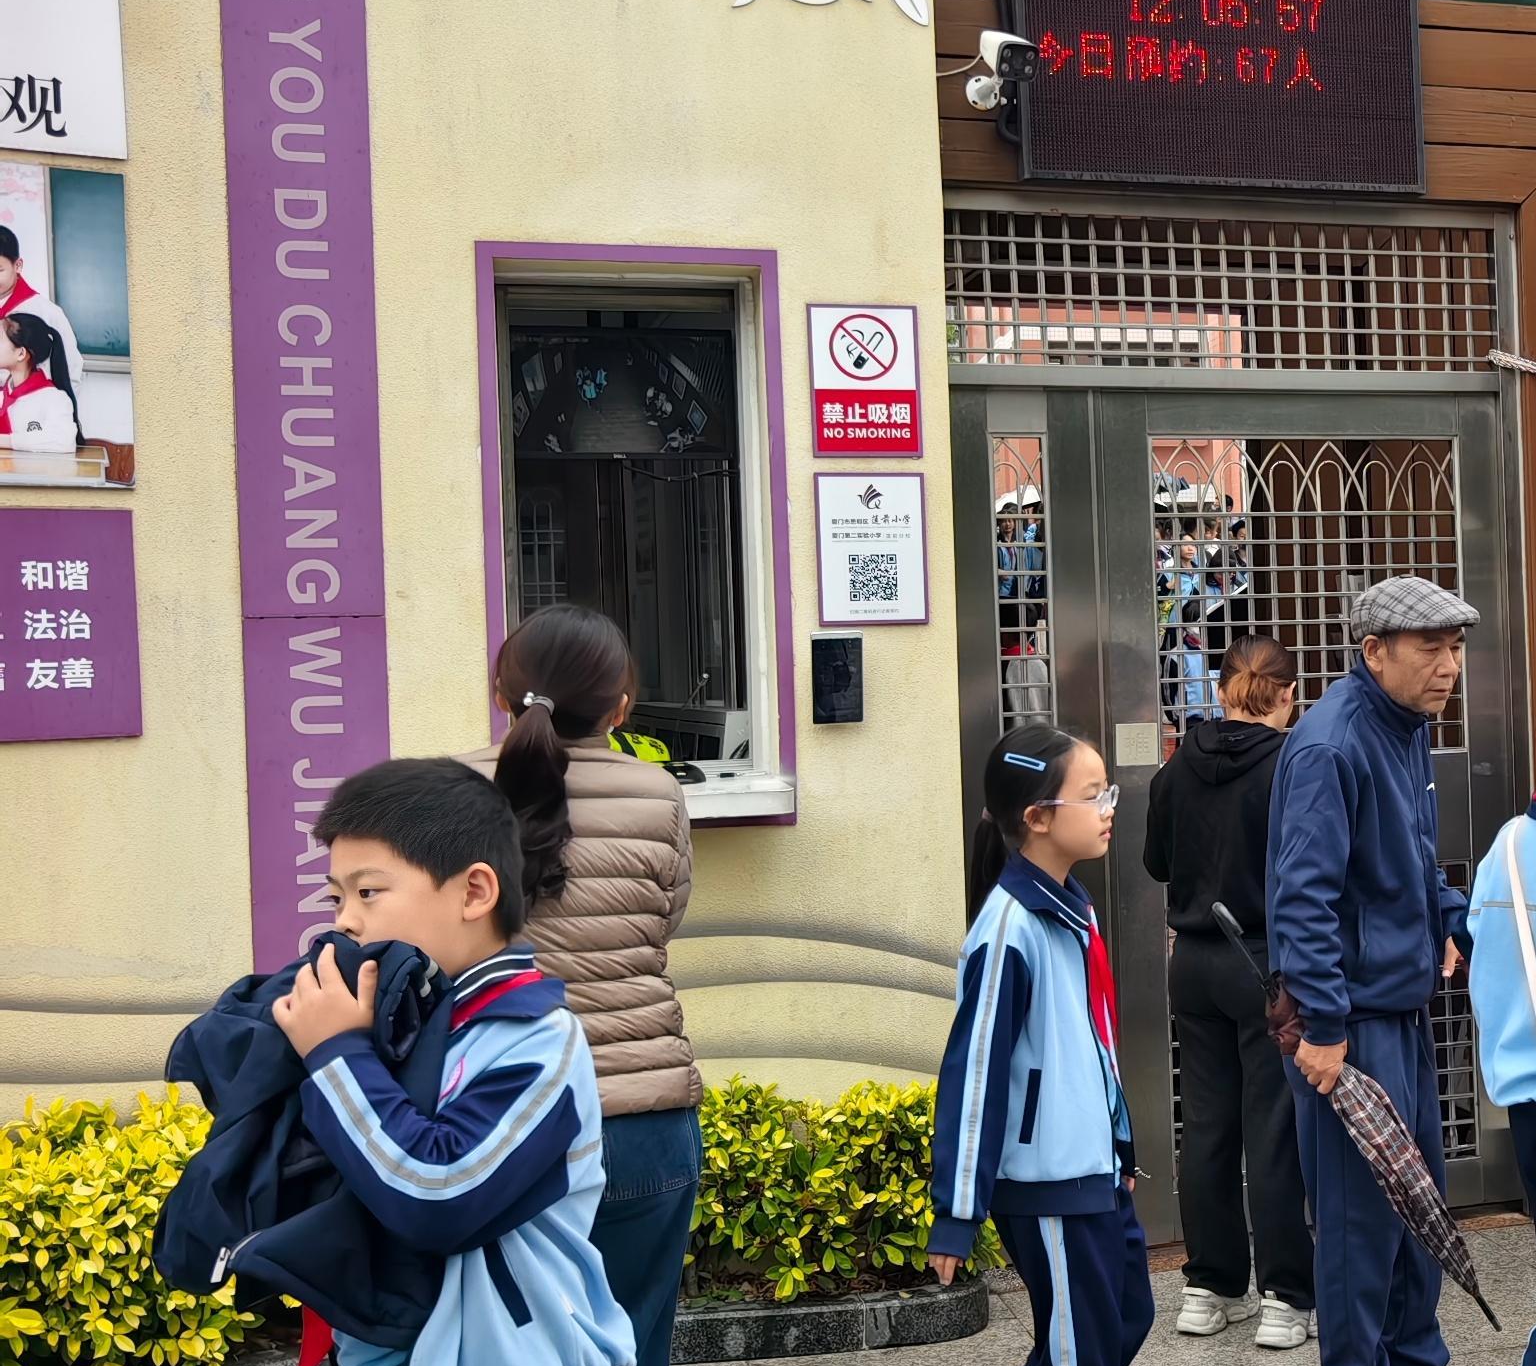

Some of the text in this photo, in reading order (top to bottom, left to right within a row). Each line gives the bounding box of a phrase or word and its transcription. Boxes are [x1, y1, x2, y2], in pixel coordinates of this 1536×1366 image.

[0, 73, 68, 138] 观
[268, 18, 327, 164] YOU
[273, 188, 331, 281] DU
[822, 402, 911, 424] 禁止吸烟
[823, 427, 911, 439] NO SMOKING
[277, 304, 341, 604] CHUANG
[20, 560, 90, 591] 和谐
[23, 609, 92, 641] 法治
[26, 657, 95, 690] 友善
[287, 625, 345, 735] WU
